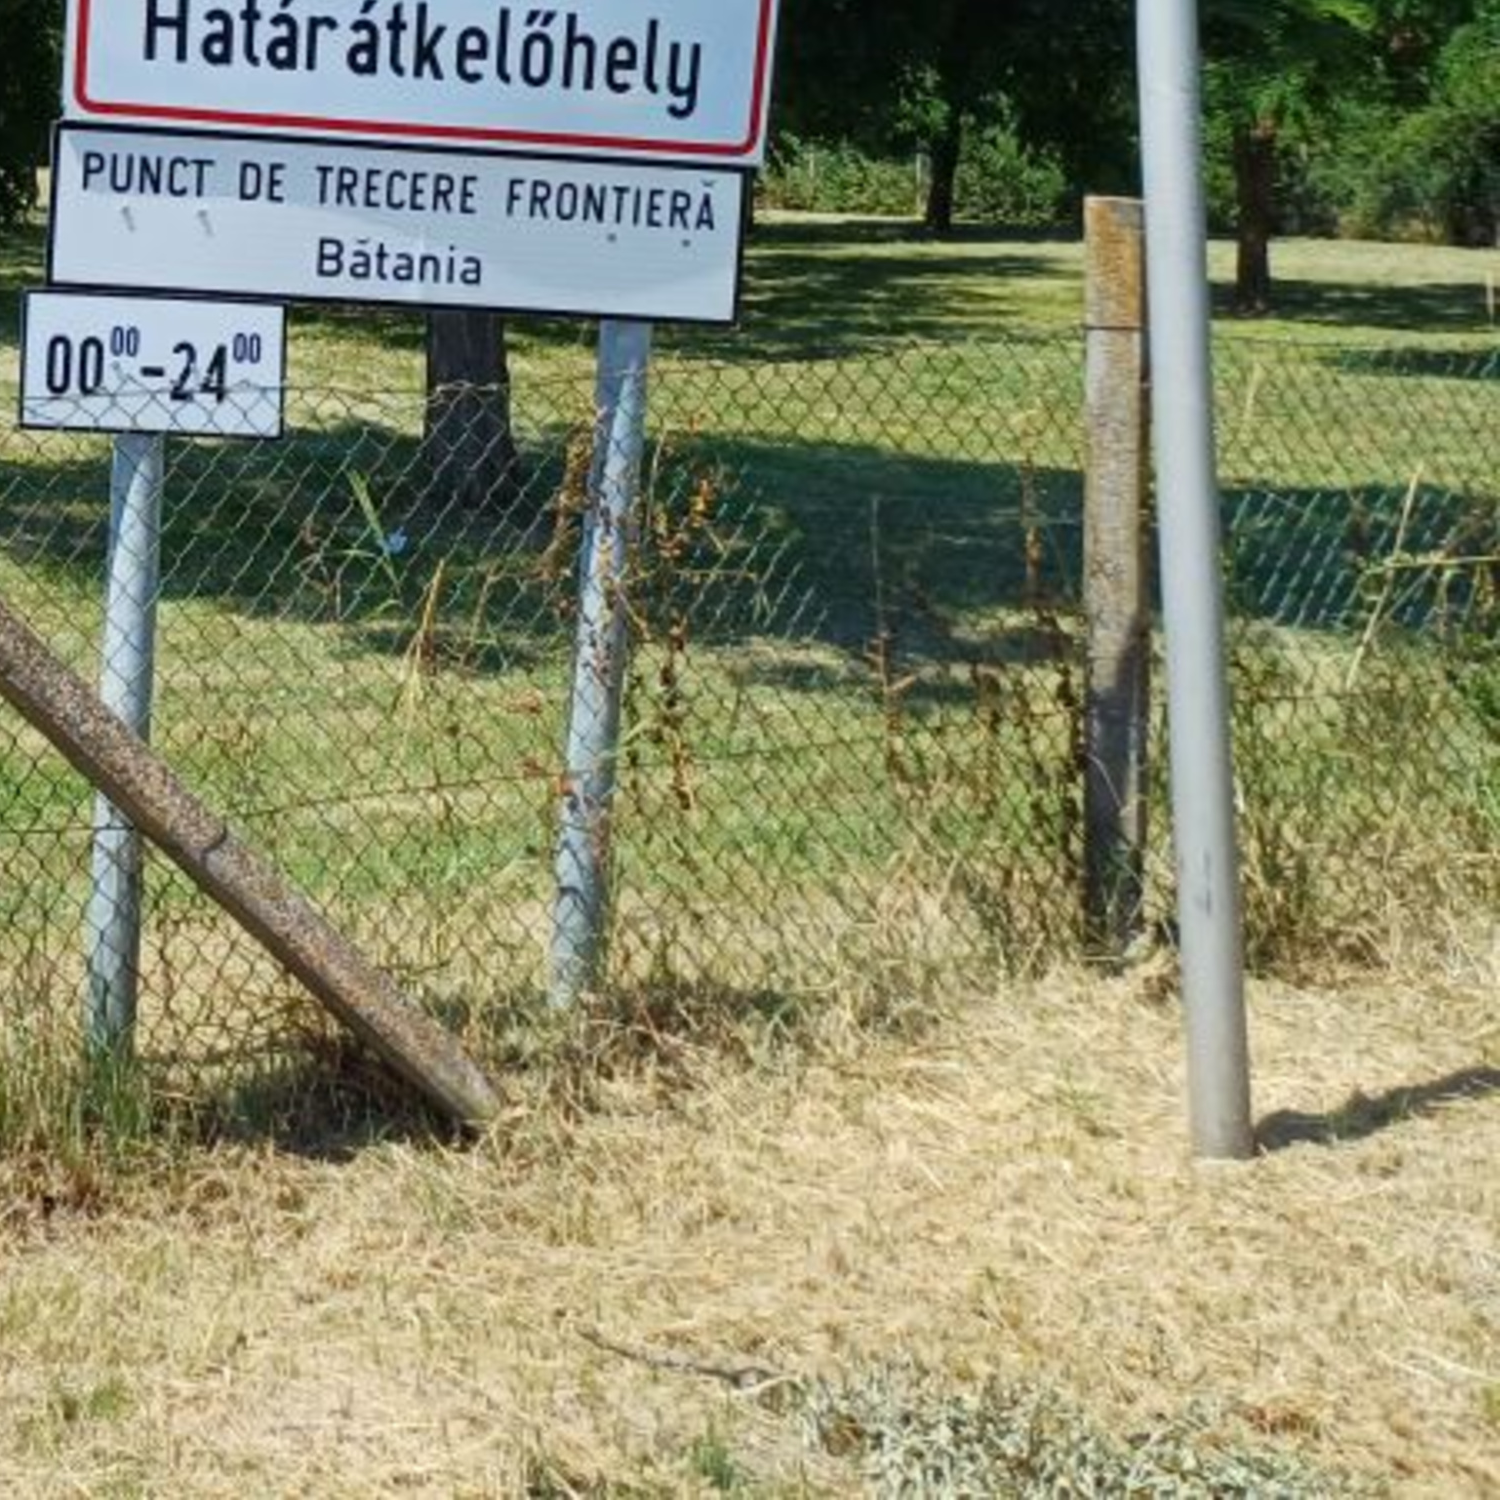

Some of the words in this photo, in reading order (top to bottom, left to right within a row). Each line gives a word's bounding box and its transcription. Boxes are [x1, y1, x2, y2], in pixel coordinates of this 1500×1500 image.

[82, 150, 216, 198] PUNCT
[238, 160, 286, 204] DE
[315, 165, 478, 215] TRECERE
[506, 179, 715, 231] FRONTIERĂ
[316, 236, 482, 286] Bătania
